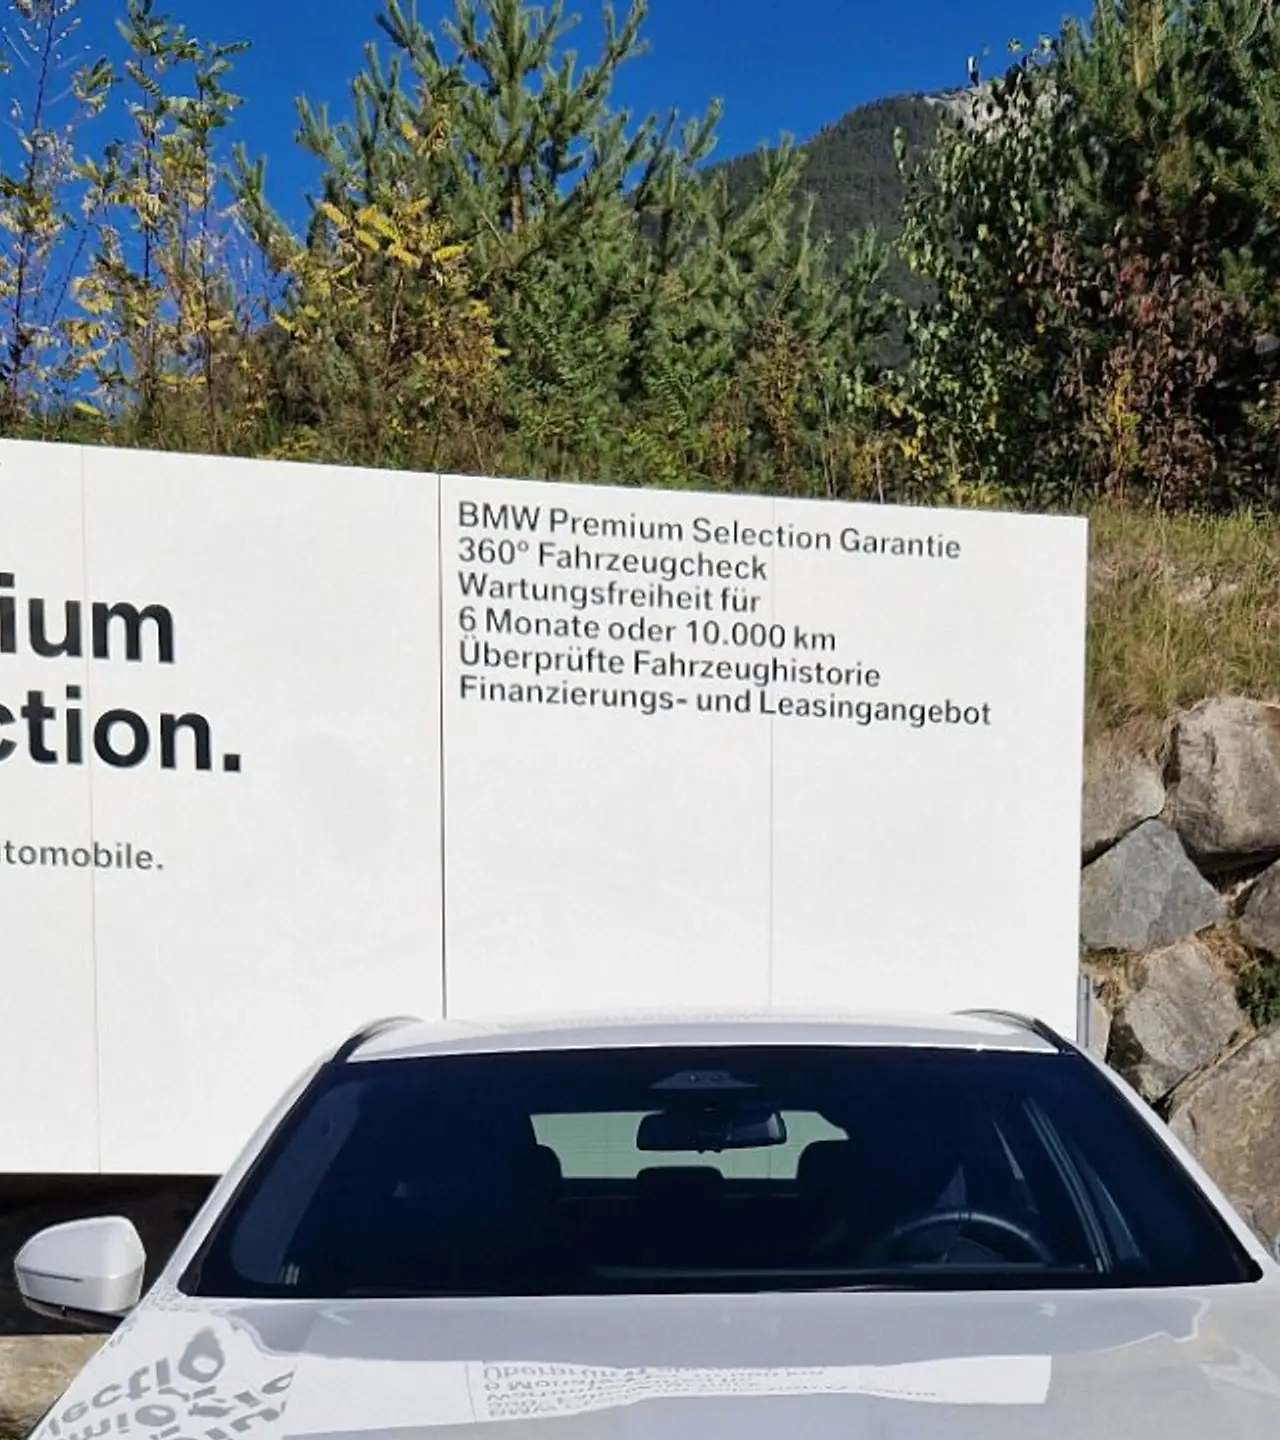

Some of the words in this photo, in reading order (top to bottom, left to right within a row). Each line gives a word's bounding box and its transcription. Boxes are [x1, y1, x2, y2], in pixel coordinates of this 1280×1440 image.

[458, 501, 541, 532] BMW
[549, 507, 684, 542] Premium
[693, 517, 831, 550] Selection
[839, 527, 962, 559] Garantie
[458, 537, 529, 565] 360°
[538, 542, 768, 581] Fahrzeugcheck
[458, 571, 713, 610] Wartungsfreiheit
[721, 587, 761, 613] für
[459, 606, 476, 631] 6
[485, 607, 600, 639] Monate
[608, 617, 676, 643] oder
[686, 620, 786, 648] 10.000
[793, 624, 836, 652] km
[459, 634, 625, 675] Überprüfte
[633, 650, 881, 688] Fahrzeughistorie
[460, 675, 688, 716] Finanzierungs-
[696, 689, 752, 713] und
[759, 690, 992, 729] Leasingangebot
